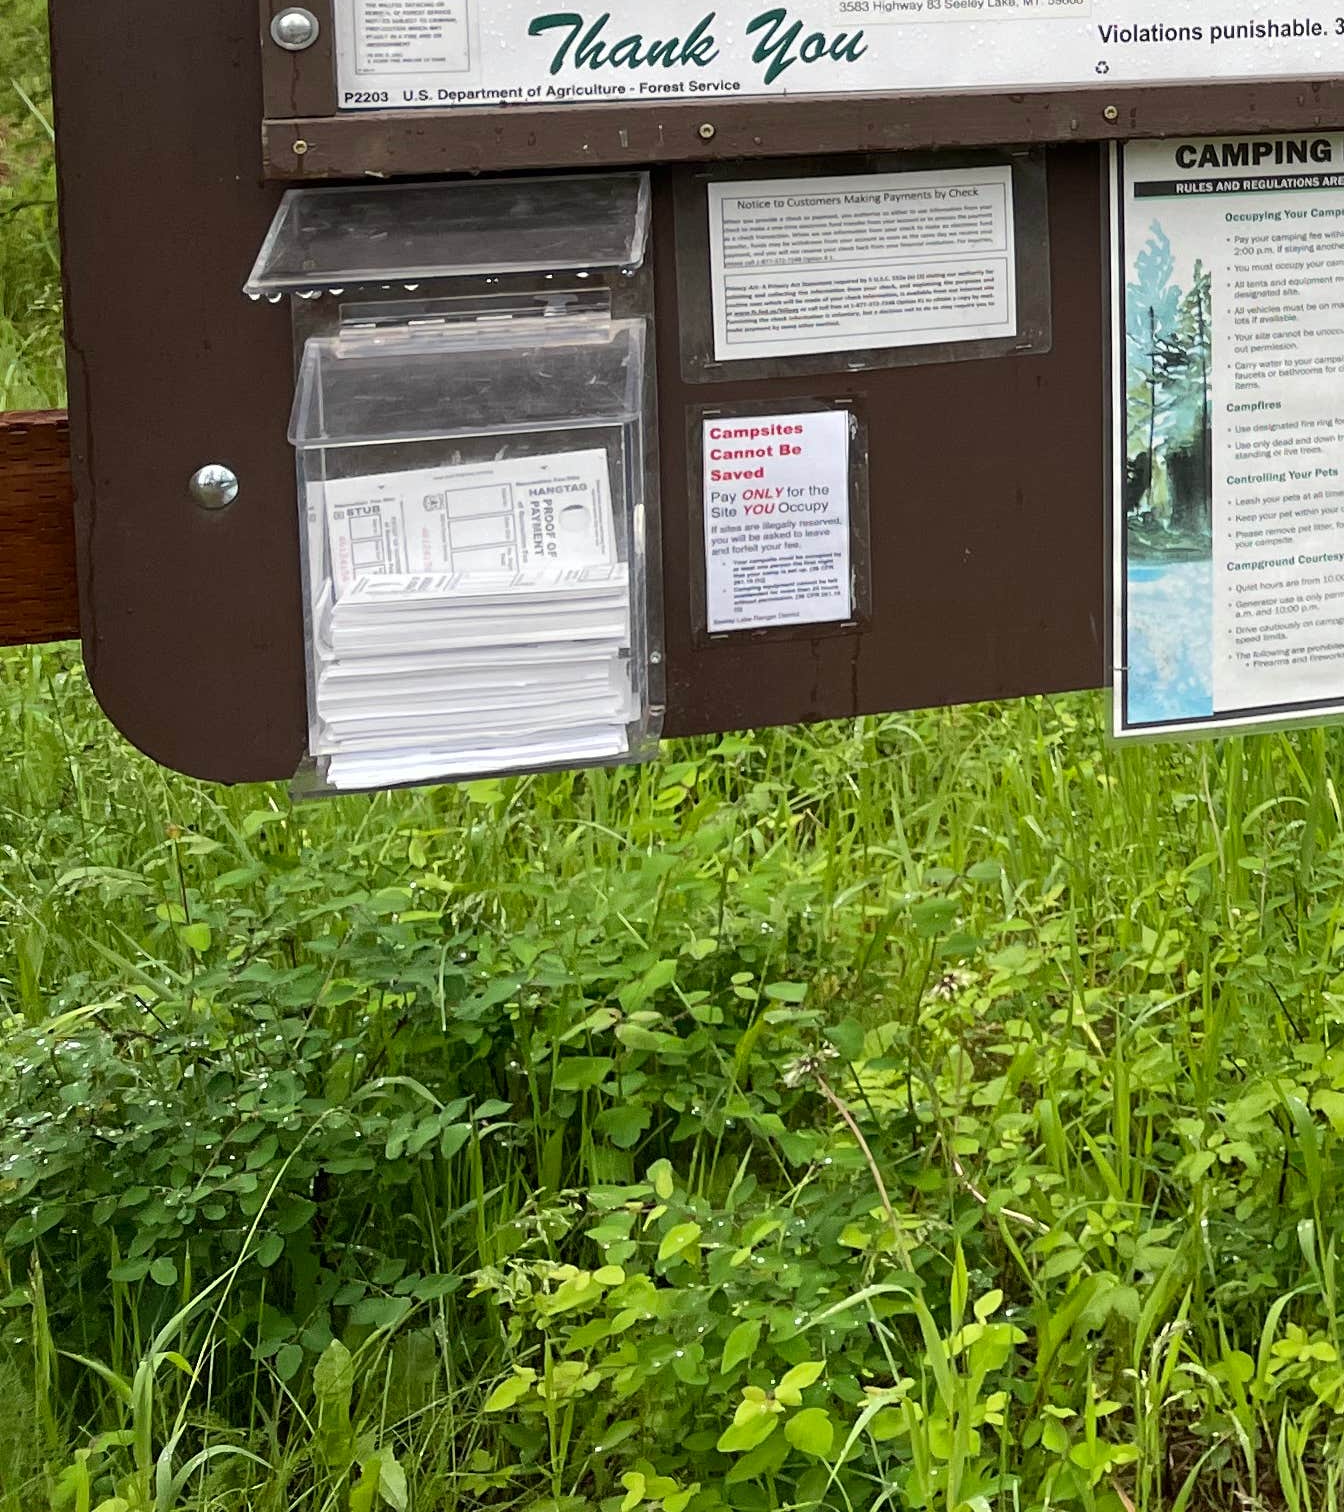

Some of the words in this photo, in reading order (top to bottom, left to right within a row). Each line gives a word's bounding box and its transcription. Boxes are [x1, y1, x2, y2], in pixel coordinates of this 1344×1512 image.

[840, 1, 869, 12] 3583
[873, 1, 923, 12] Highway
[927, 0, 941, 9] 83
[1098, 24, 1202, 43] Violations
[1211, 19, 1327, 43] punishable.
[528, 12, 719, 75] Thank
[746, 8, 868, 85] You
[1176, 139, 1331, 168] CAMPING
[1177, 183, 1213, 193] RULES
[1216, 181, 1240, 191] AND
[1243, 177, 1319, 190] REGULATIONS
[1322, 176, 1344, 186] ARE
[737, 201, 770, 209] Notice
[774, 199, 784, 209] to
[787, 198, 841, 207] Customers
[844, 194, 880, 204] Making
[884, 190, 932, 204] Payments
[935, 190, 946, 200] by
[949, 188, 978, 197] Check
[710, 424, 803, 440] Campsites
[711, 446, 773, 460] Cannot
[780, 445, 801, 455] Be
[711, 467, 764, 481] Saved
